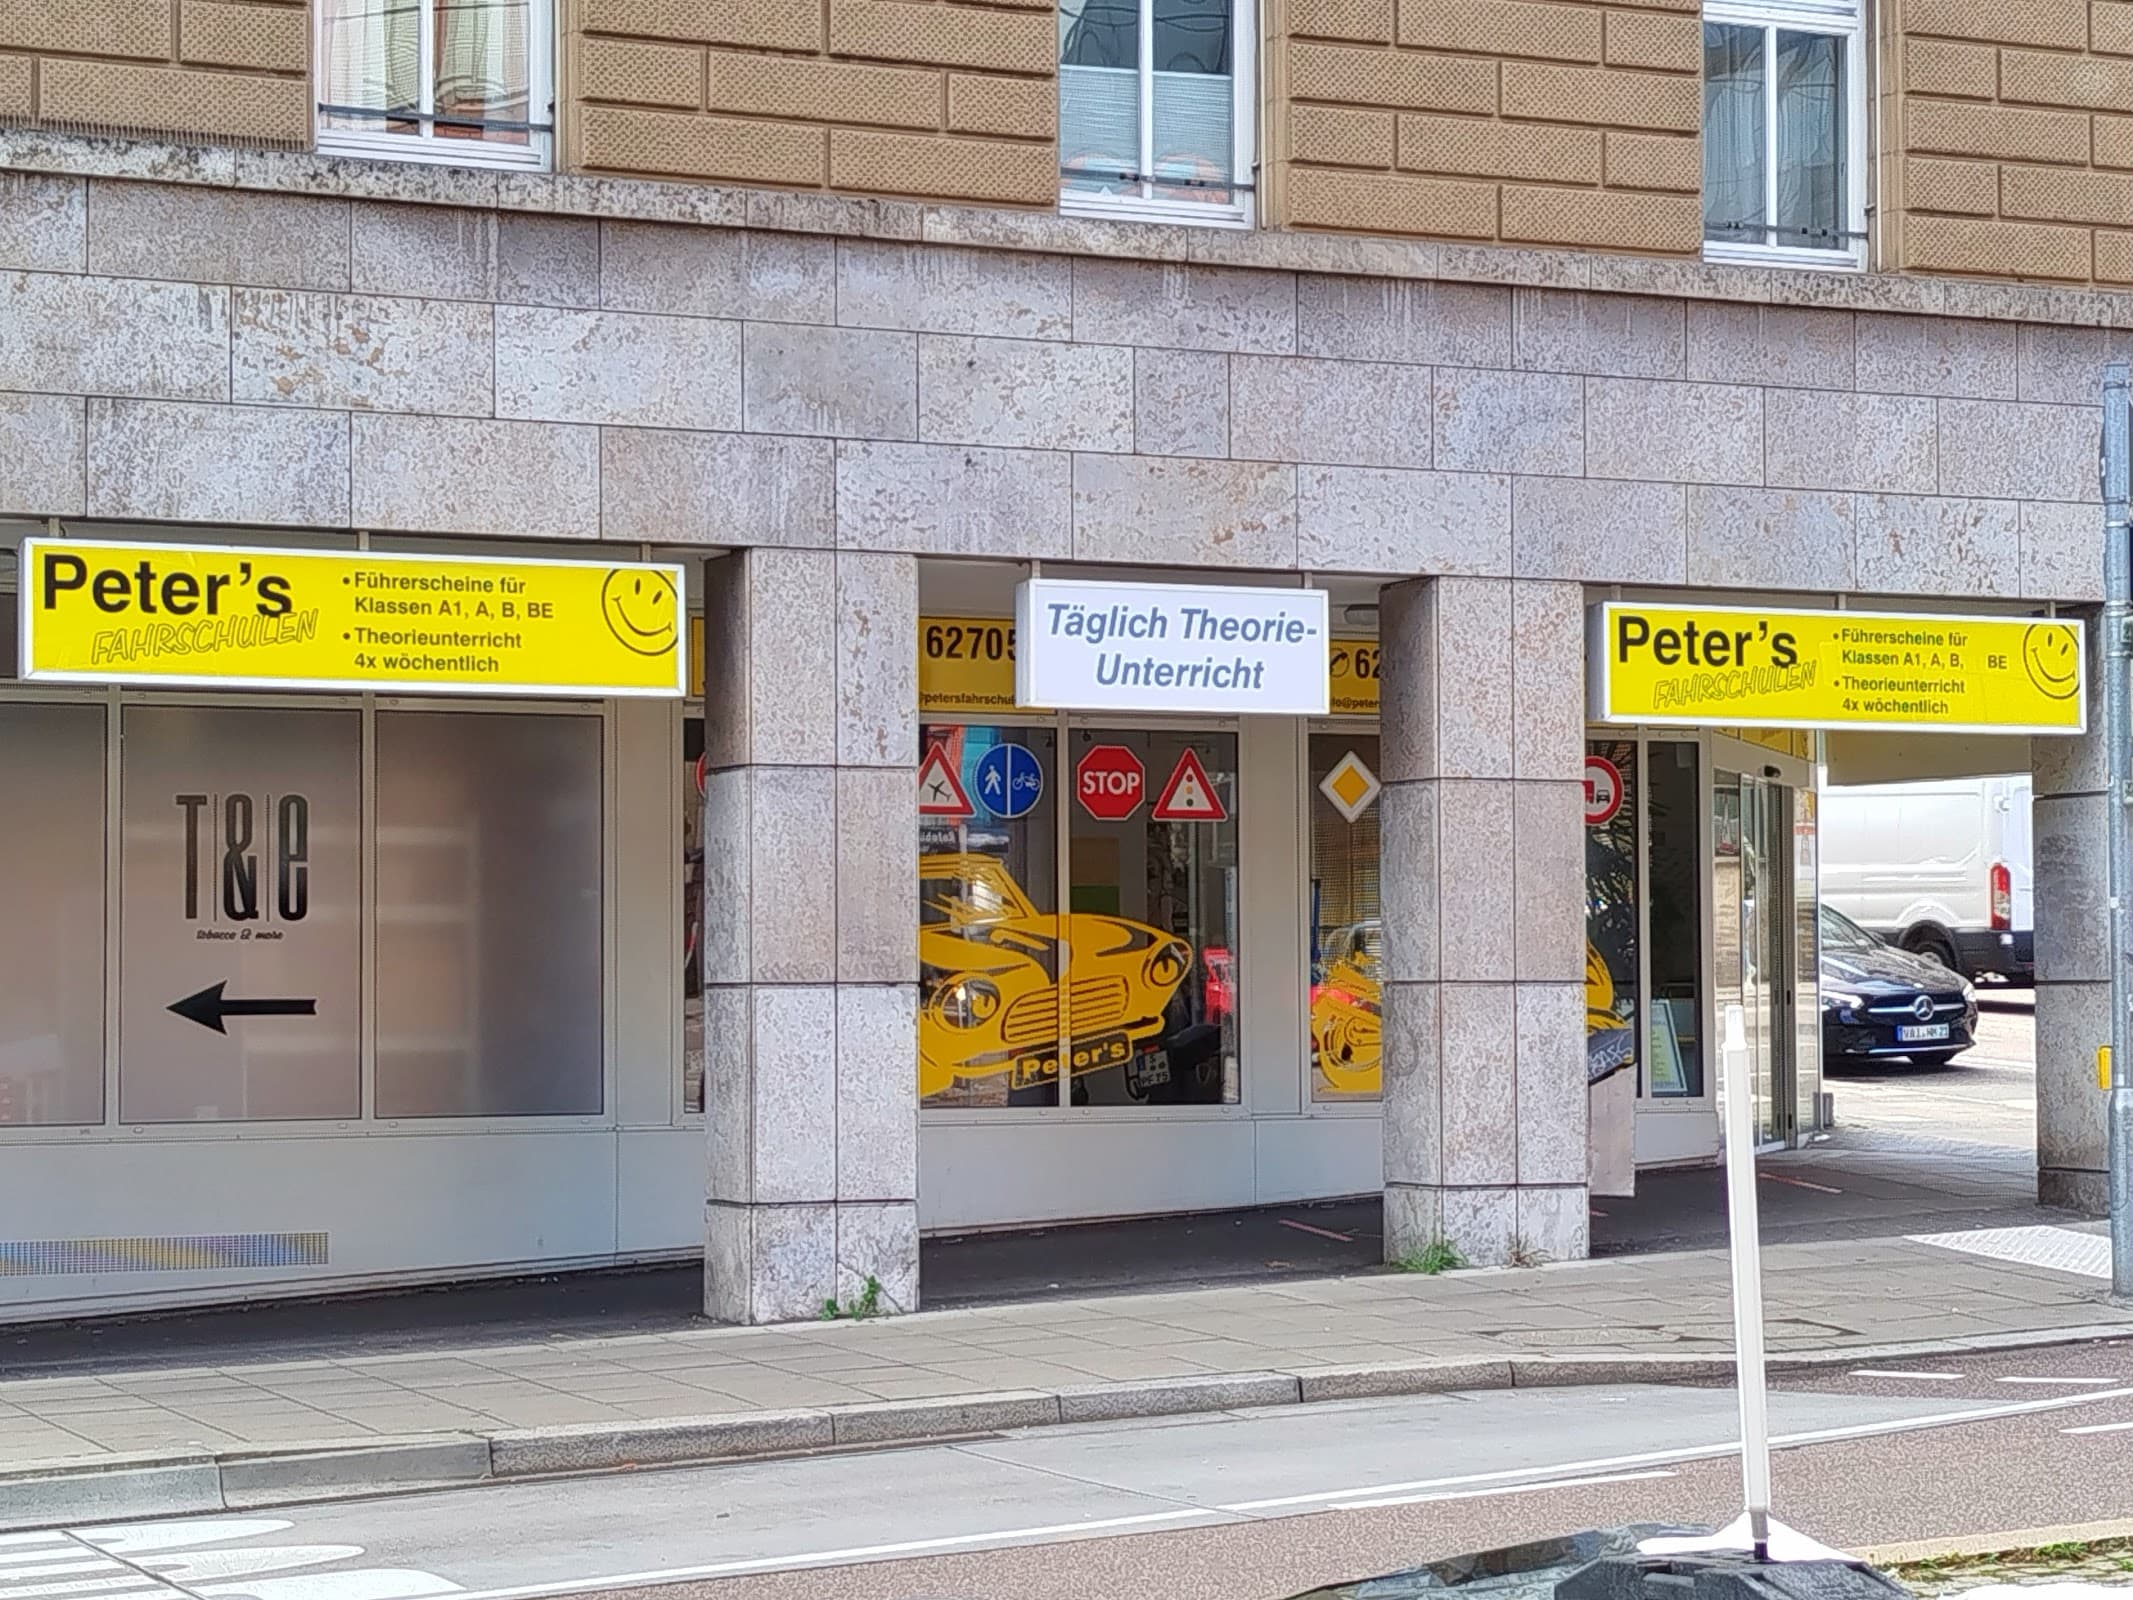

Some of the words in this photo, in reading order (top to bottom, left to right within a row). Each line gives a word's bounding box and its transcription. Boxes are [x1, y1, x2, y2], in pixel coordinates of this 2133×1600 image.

[44, 553, 292, 618] Peter’s
[355, 571, 493, 593] Führerscheine
[500, 576, 526, 594] für
[355, 597, 432, 615] Klassen
[438, 600, 469, 619] A1,
[475, 601, 495, 620] A,
[502, 602, 521, 620] B,
[527, 602, 553, 619] BE
[1048, 603, 1168, 644] Täglich
[1180, 607, 1317, 643] Theorie-
[91, 608, 318, 665] FAHRSCHULEN
[354, 627, 521, 648] Theorieunterricht
[1618, 615, 1797, 669] Peter’s
[1841, 628, 1943, 647] Führerscheine
[1949, 632, 1968, 647] für
[354, 653, 377, 669] 4x
[383, 654, 499, 672] wöchentlich
[1097, 653, 1264, 689] Unterricht
[1841, 650, 1899, 665] Klassen
[1903, 652, 1926, 669] A1,
[1930, 653, 1945, 669] A,
[1950, 654, 1964, 669] B,
[1987, 655, 2008, 669] BE
[1653, 660, 1816, 709] FAHRSCHULEN
[1842, 675, 1965, 694] Theorieunterricht
[1842, 698, 1859, 711] 4x
[1864, 699, 1948, 714] wöchentlich
[1082, 771, 1140, 795] STOP
